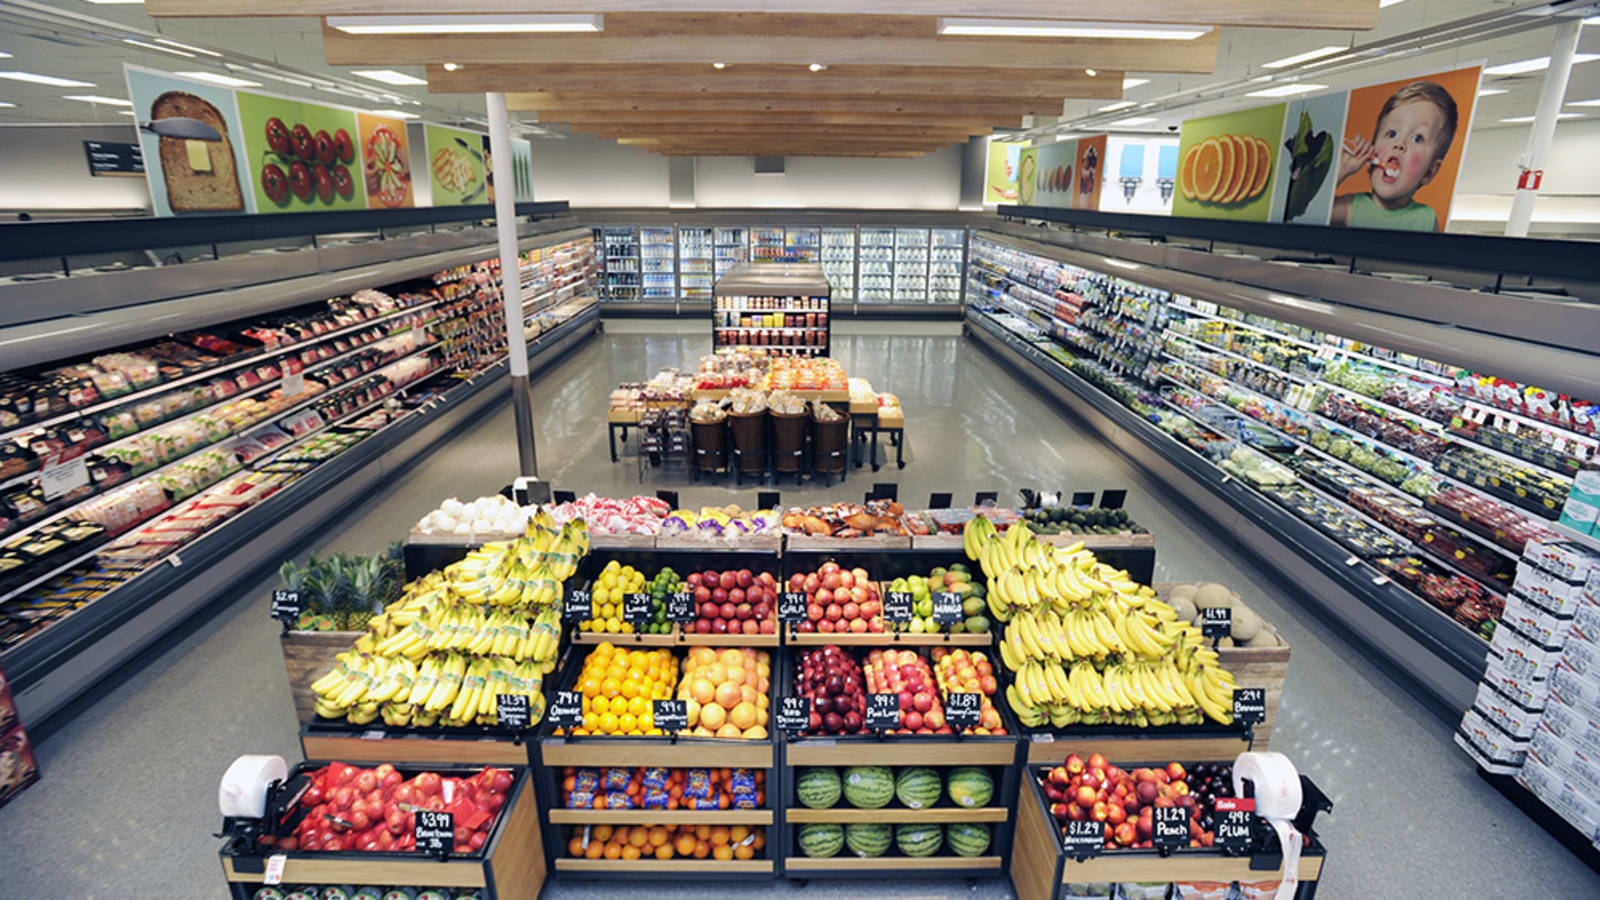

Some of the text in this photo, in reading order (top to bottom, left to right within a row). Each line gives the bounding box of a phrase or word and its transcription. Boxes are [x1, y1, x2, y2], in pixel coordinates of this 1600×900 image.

[421, 812, 450, 828] $3.99
[1156, 807, 1186, 821] $1.29
[1069, 821, 1100, 835] $1.29
[1219, 824, 1250, 837] PLUM
